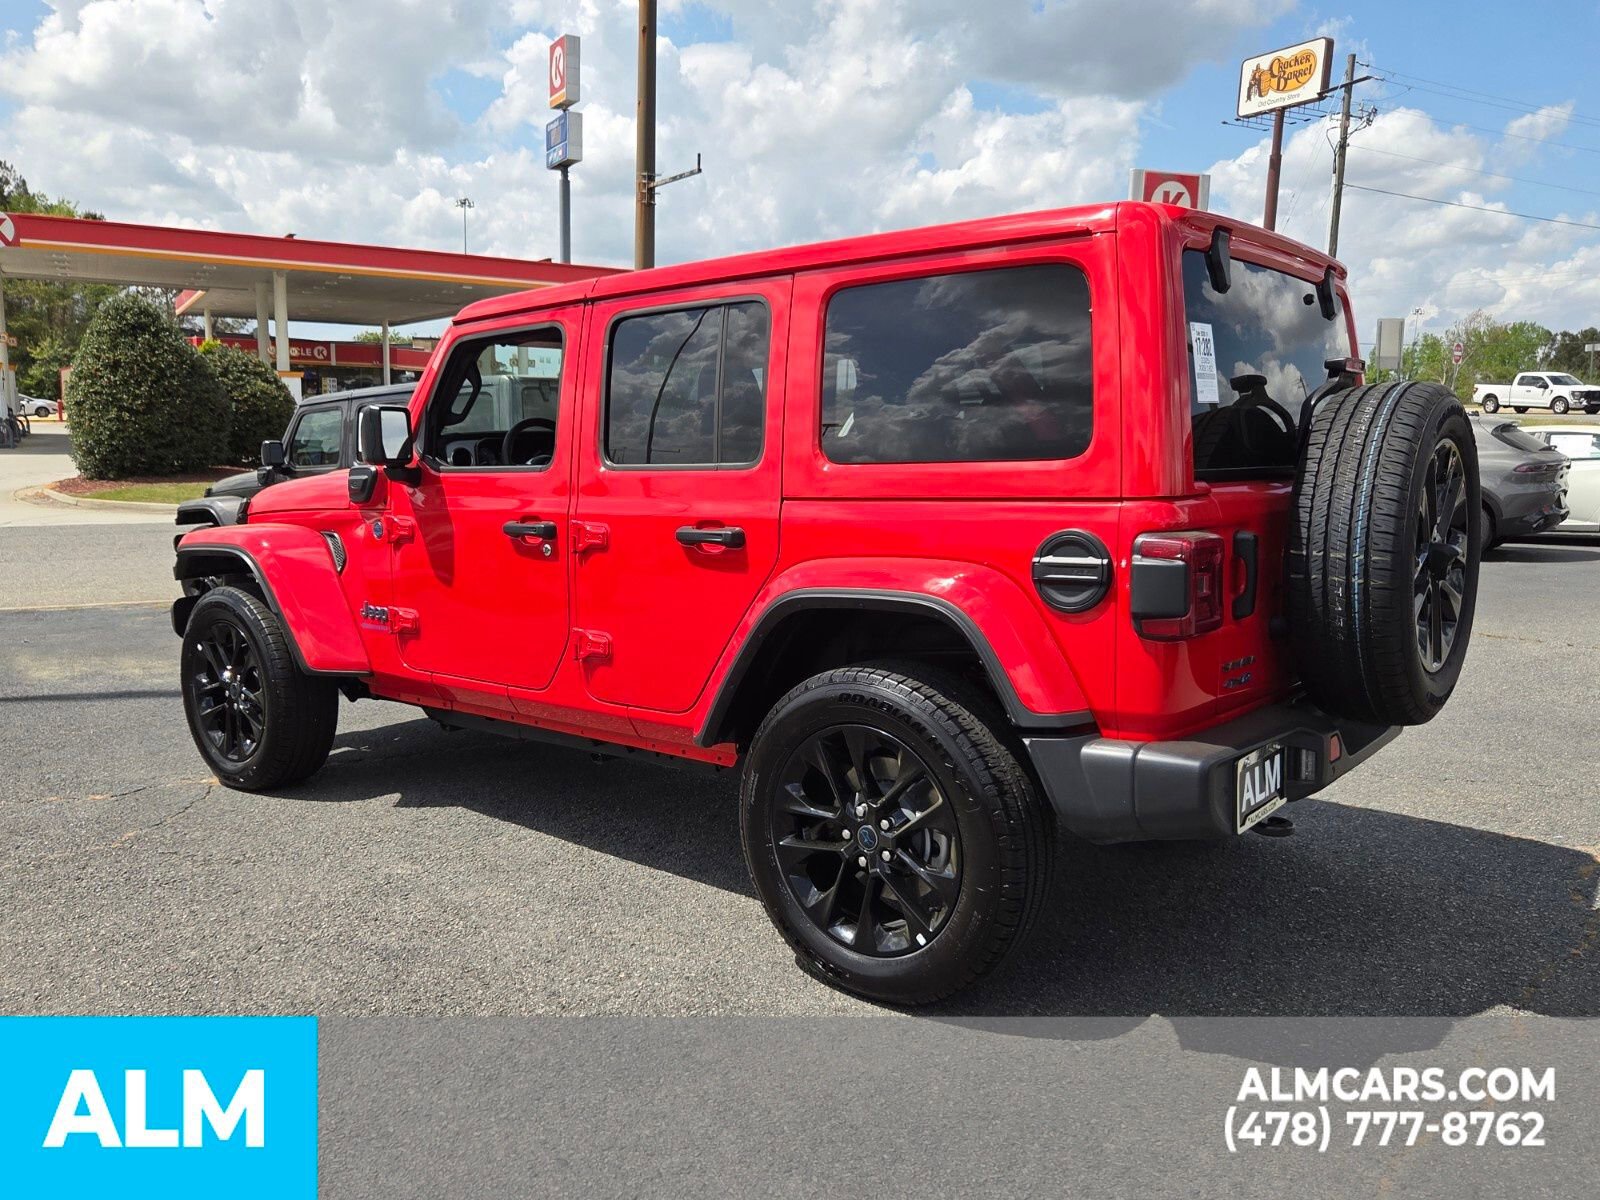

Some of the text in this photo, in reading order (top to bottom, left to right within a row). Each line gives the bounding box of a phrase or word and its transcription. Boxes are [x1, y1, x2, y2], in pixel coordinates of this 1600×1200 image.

[1269, 53, 1311, 78] Cracker
[1276, 63, 1313, 91] Barrel
[1257, 92, 1300, 107] Old Country Store
[361, 601, 388, 624] Jeep
[1241, 753, 1281, 813] ALM
